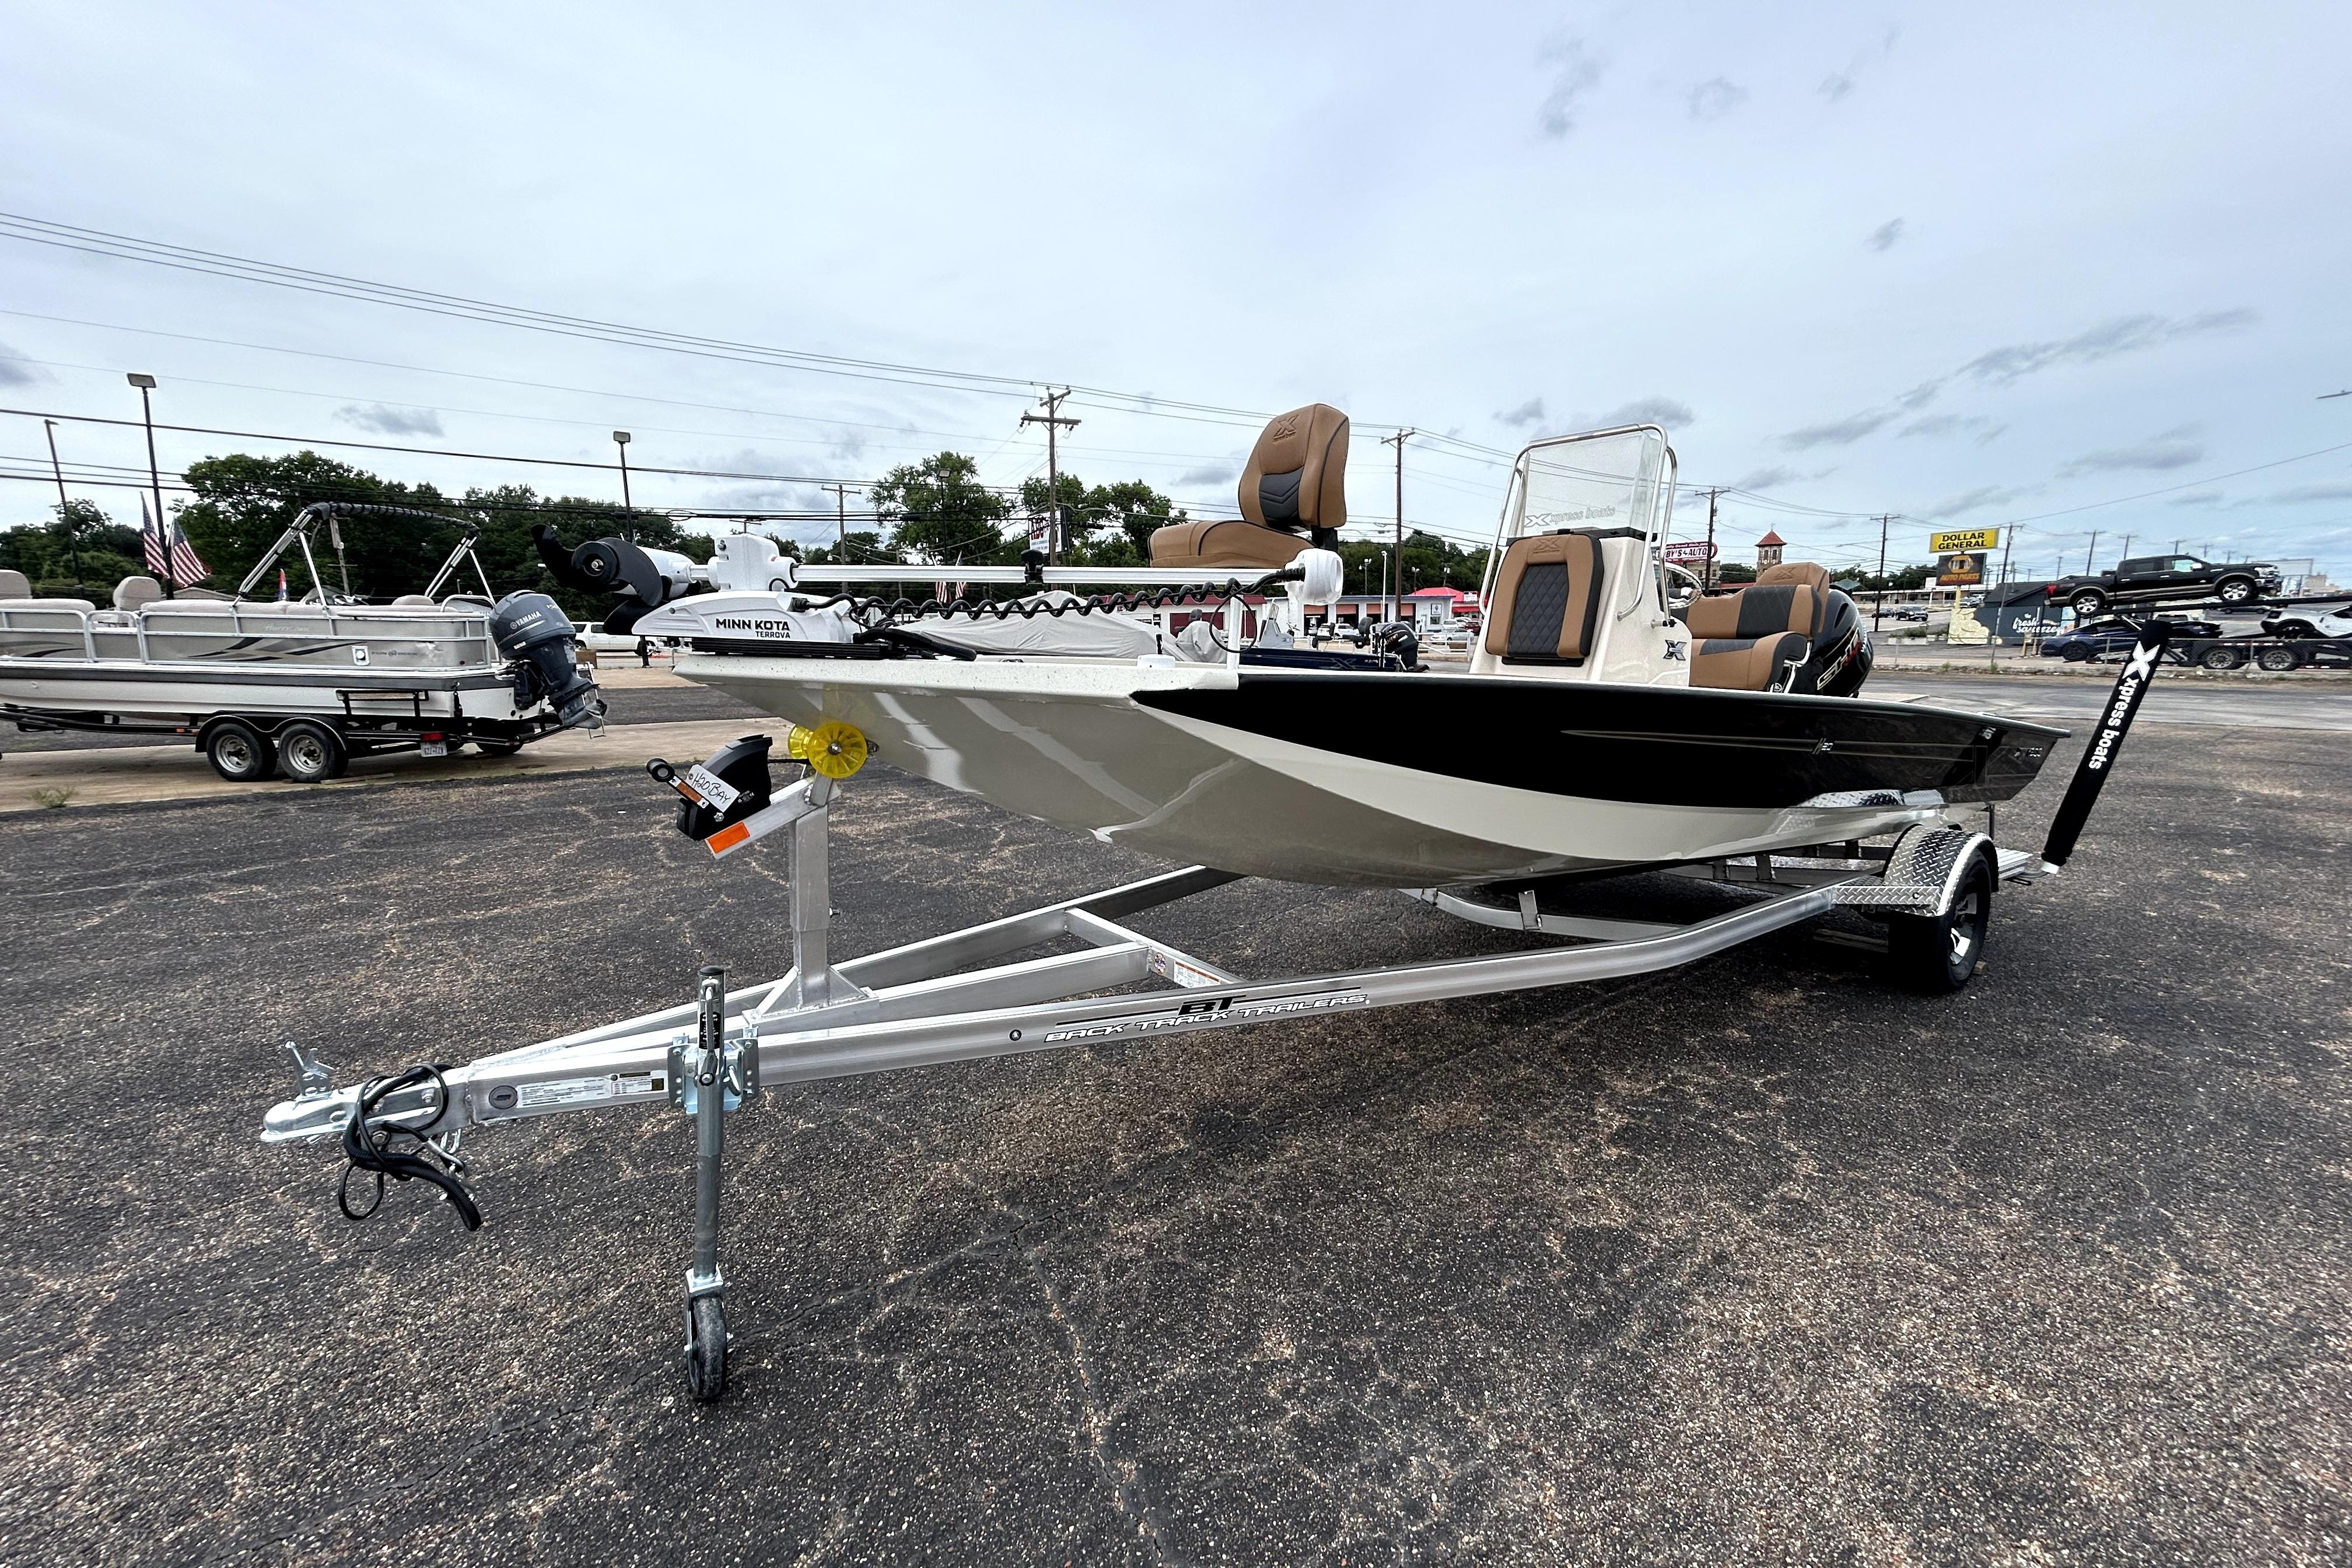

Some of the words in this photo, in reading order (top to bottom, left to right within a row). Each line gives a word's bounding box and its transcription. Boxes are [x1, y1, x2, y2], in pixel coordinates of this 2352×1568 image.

[1549, 511, 1584, 524] xpress
[1585, 505, 1616, 520] boats
[1942, 532, 1985, 542] DOLLAR
[1938, 540, 1987, 550] GENERAL
[1665, 550, 1682, 558] BY'S
[1688, 548, 1707, 556] AUTO
[515, 611, 541, 626] YAMAHA
[715, 618, 751, 629] MINN
[754, 620, 790, 631] KOTA
[2013, 617, 2038, 629] fresh
[755, 631, 791, 639] TERROVA
[2107, 677, 2140, 727] xpress
[2088, 729, 2120, 770] boats
[1178, 994, 1247, 1016] BT
[1043, 1022, 1132, 1043] BACK
[1134, 1009, 1237, 1031] TRACK
[1237, 993, 1368, 1019] TRAILERS
